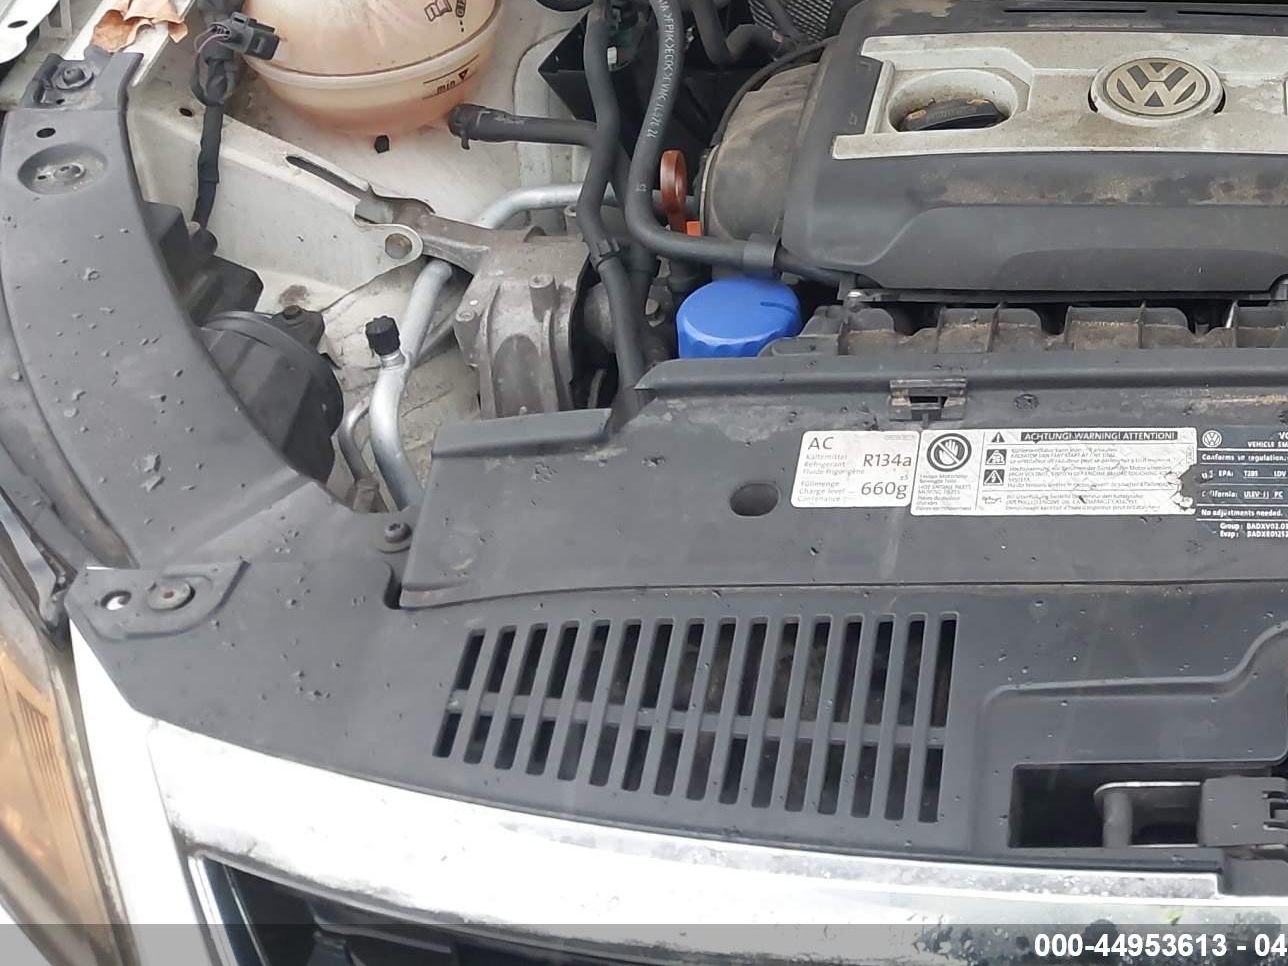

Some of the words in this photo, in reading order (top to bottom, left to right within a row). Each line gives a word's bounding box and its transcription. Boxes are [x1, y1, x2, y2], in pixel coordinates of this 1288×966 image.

[437, 80, 456, 95] min
[808, 436, 834, 450] AC
[863, 454, 912, 467] R134a
[862, 482, 908, 500] 660g
